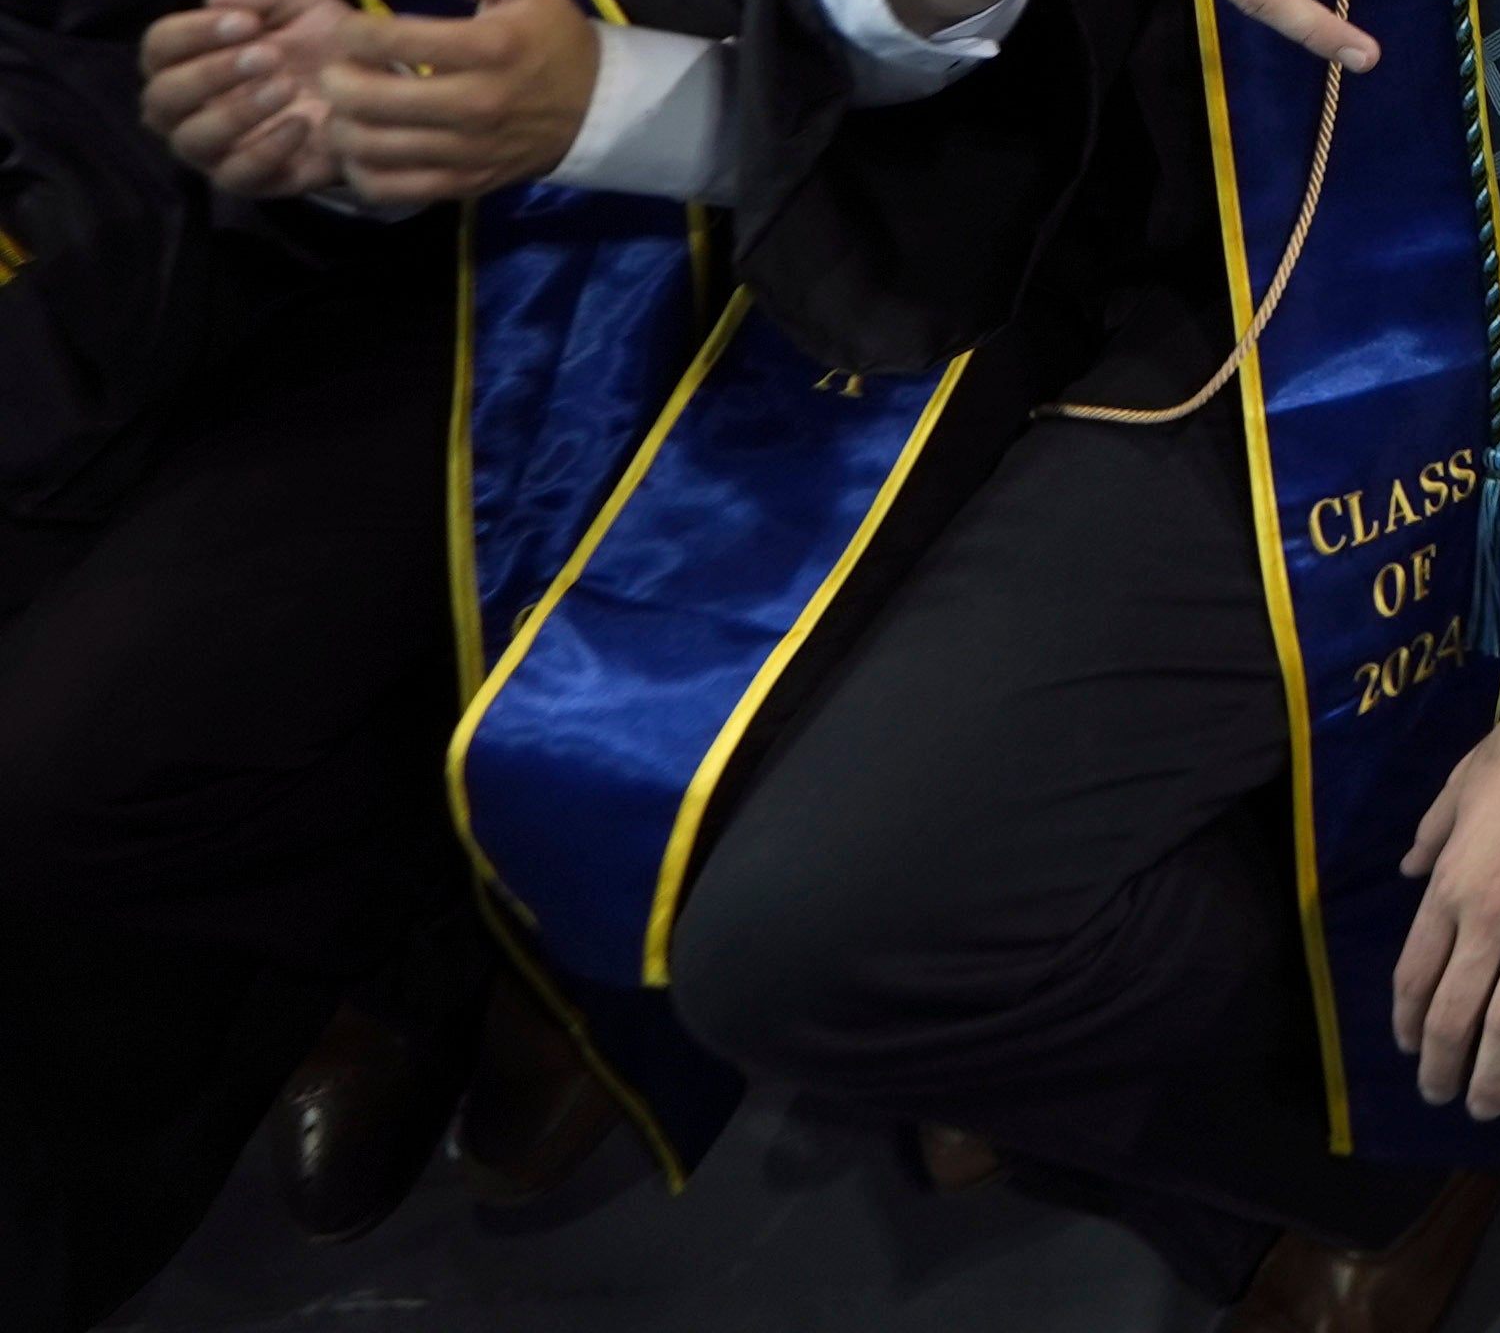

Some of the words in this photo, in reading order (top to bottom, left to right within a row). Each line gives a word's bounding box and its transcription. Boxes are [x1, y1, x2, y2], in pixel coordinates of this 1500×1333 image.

[1309, 448, 1477, 556] CLASS
[1373, 543, 1437, 618] OF
[1354, 615, 1474, 717] 2024
